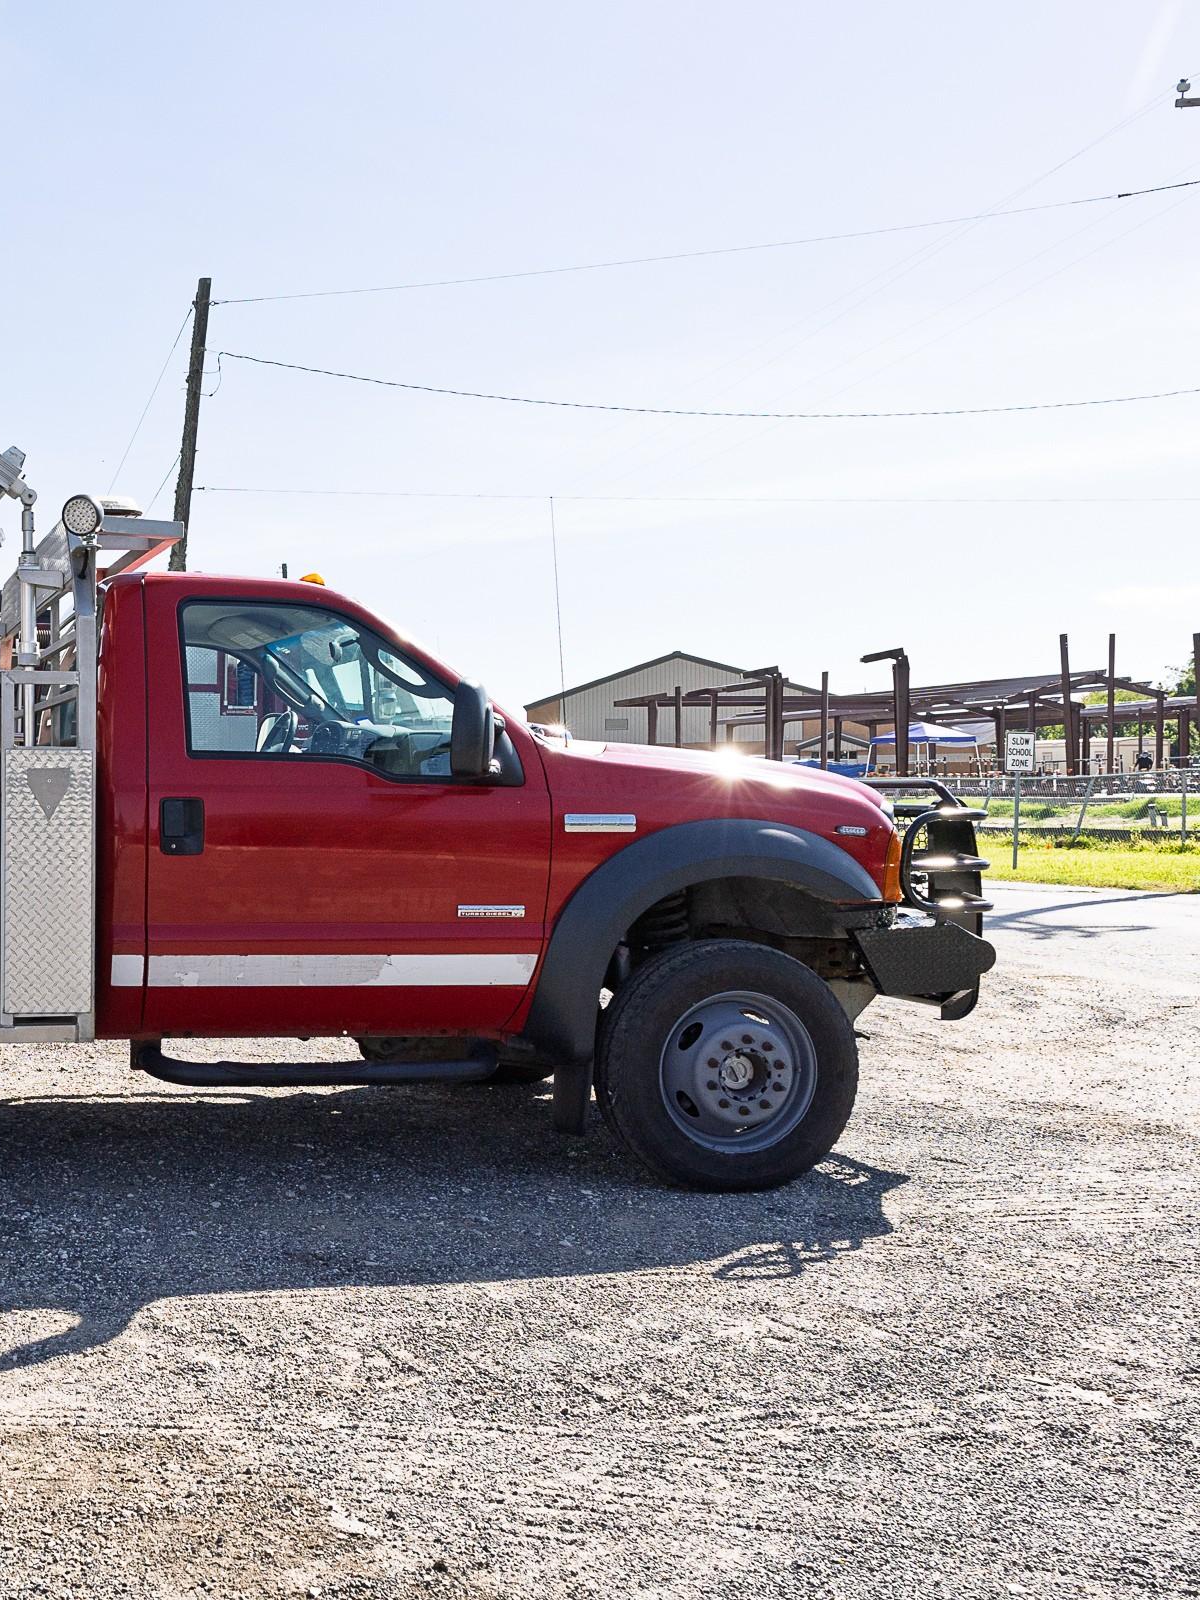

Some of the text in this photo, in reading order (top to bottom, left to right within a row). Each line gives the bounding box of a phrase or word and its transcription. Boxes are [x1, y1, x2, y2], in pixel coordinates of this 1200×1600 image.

[1012, 737, 1030, 745] SLOW
[1008, 748, 1032, 757] SCHOOL
[1011, 759, 1029, 768] ZONE
